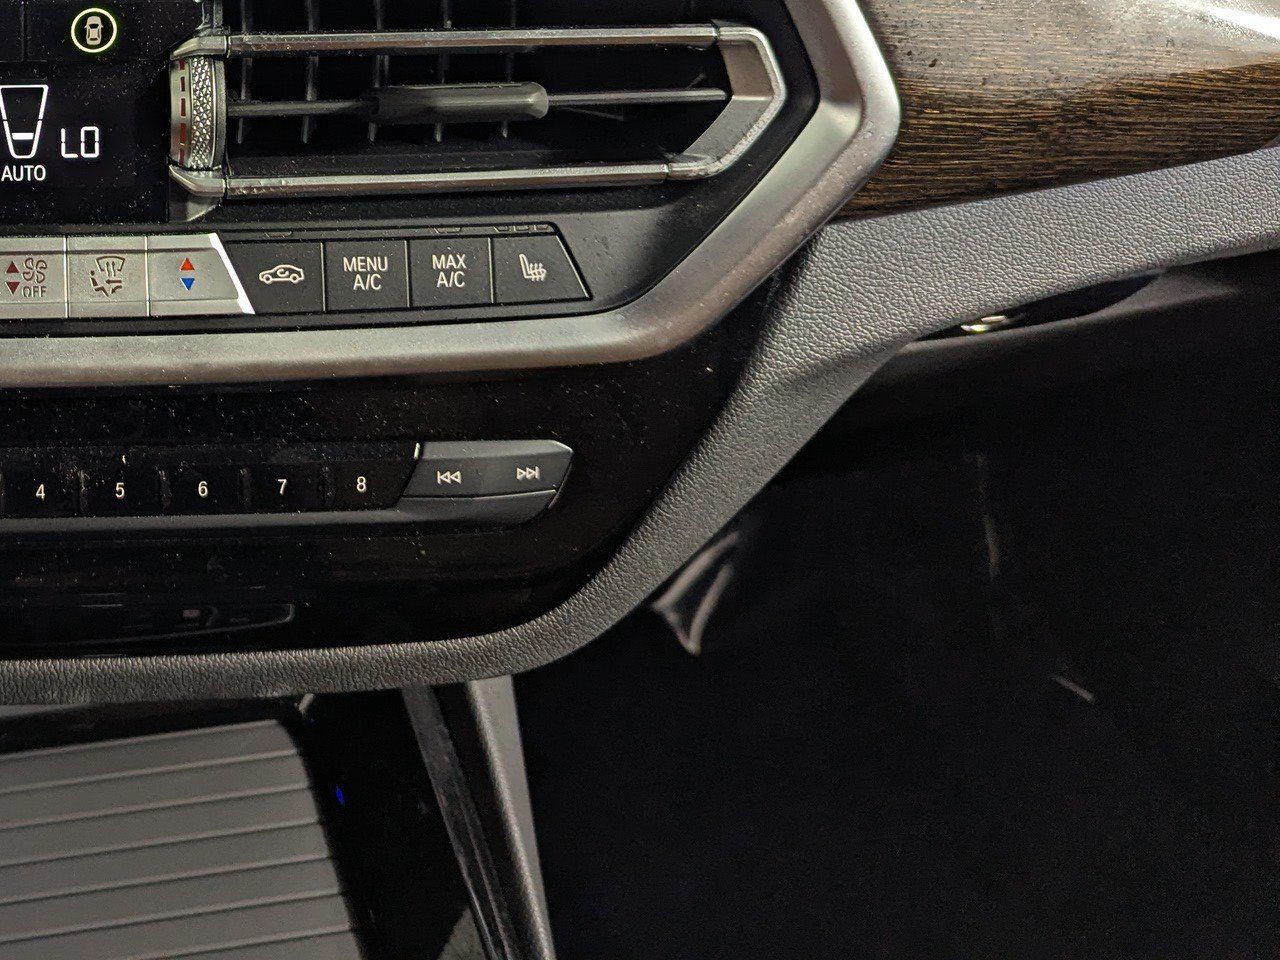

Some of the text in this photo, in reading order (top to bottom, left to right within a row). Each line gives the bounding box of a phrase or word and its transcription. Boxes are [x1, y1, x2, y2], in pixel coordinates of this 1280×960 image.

[61, 126, 100, 159] LO
[1, 165, 46, 182] AUTO
[343, 256, 389, 272] MENU
[432, 254, 467, 270] MAX
[353, 274, 382, 291] A/C
[437, 271, 466, 288] A/C
[23, 285, 46, 297] OFF
[35, 483, 46, 500] 4
[115, 482, 125, 499] 5
[198, 480, 208, 497] 6
[277, 479, 288, 496] 7
[356, 476, 366, 493] 8
